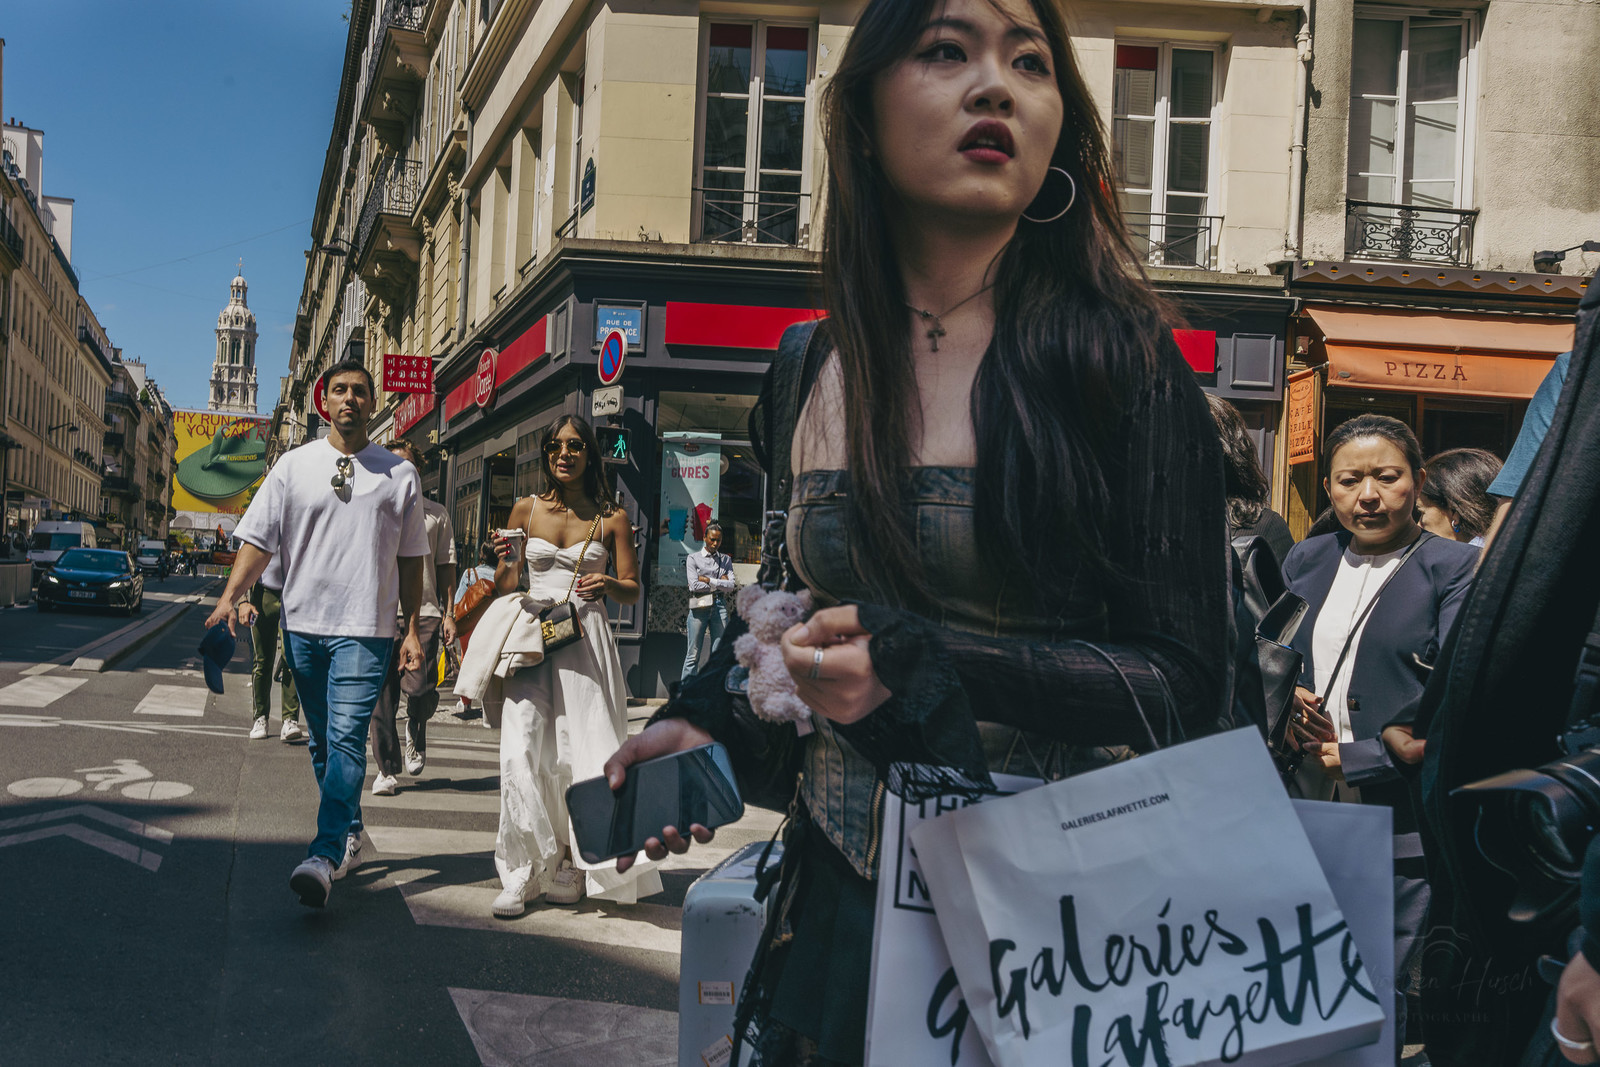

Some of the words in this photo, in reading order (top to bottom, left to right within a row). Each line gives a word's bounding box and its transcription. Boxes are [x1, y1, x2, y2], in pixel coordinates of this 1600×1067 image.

[600, 327, 637, 336] PRNCE
[1384, 361, 1468, 381] PIZZA
[201, 413, 230, 426] RUN
[187, 424, 216, 437] YOU
[221, 426, 250, 440] CAN
[1061, 793, 1170, 831] GALERIESLAFAYETTE.COM
